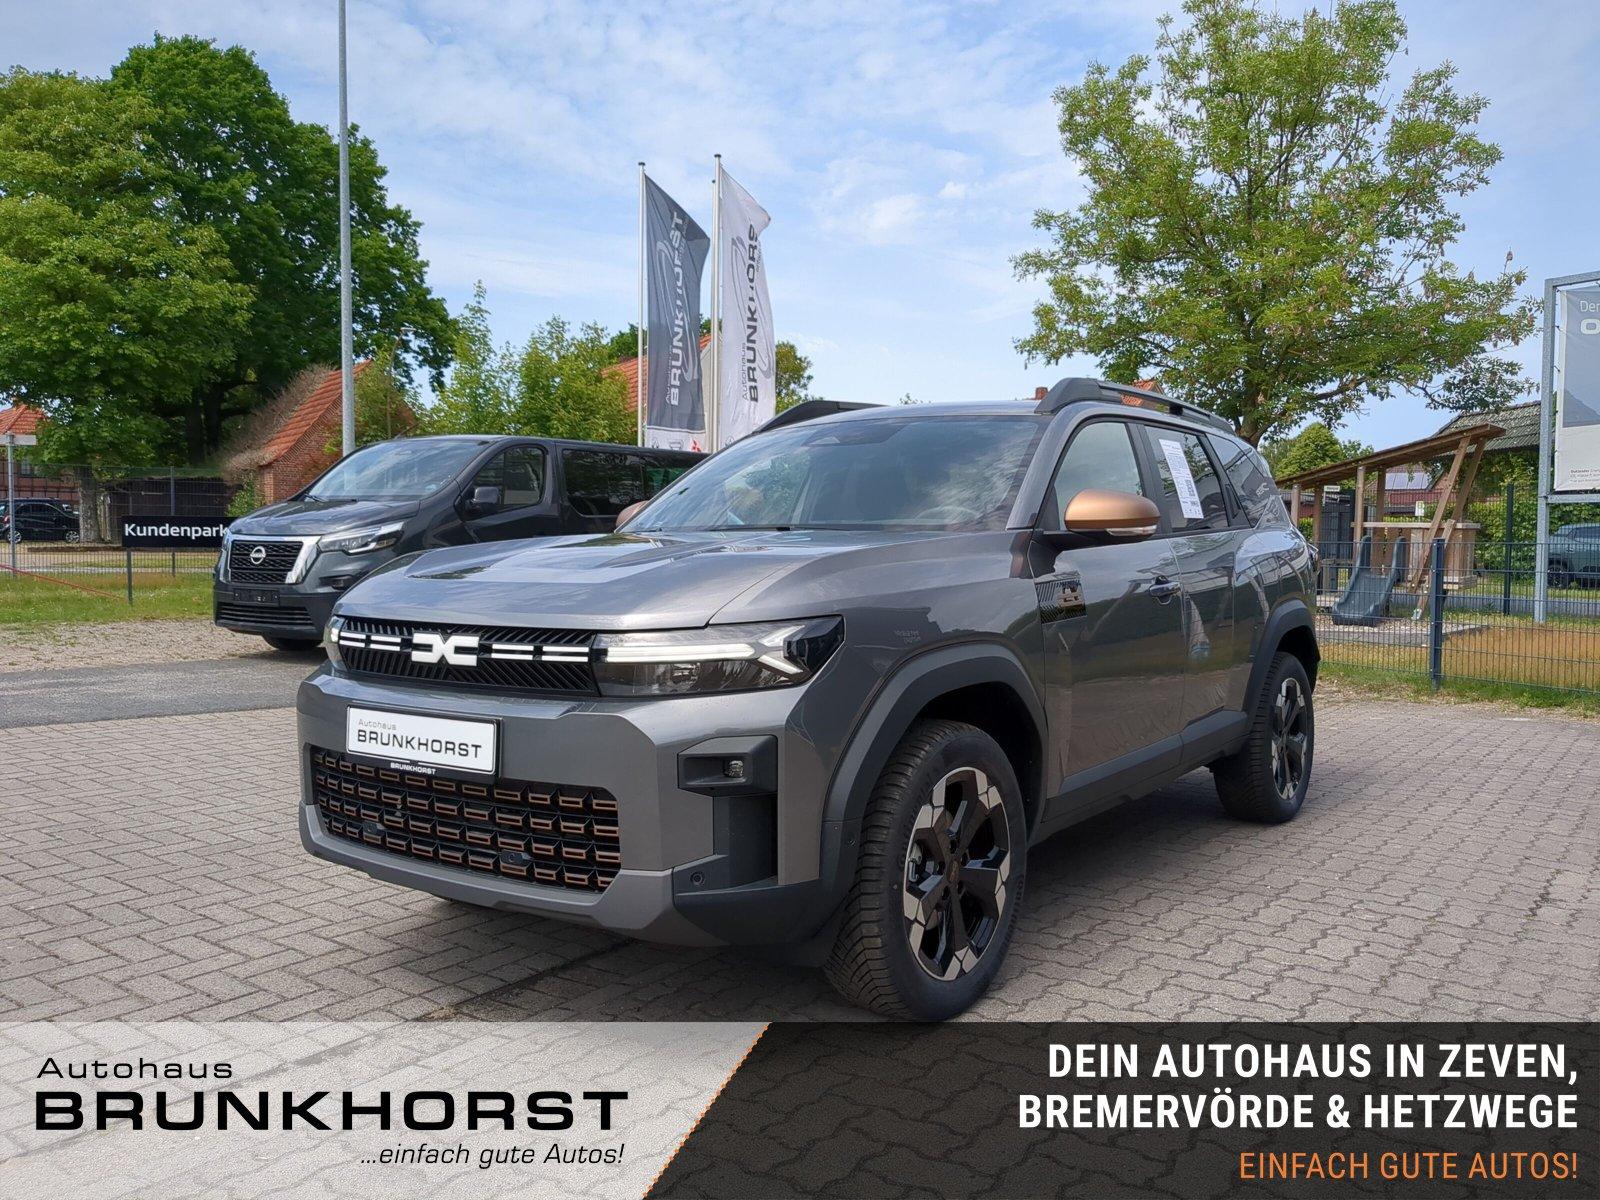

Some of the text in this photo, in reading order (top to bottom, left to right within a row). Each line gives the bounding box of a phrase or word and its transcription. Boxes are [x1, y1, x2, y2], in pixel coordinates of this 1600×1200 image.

[358, 718, 397, 731] Autohaus
[357, 729, 482, 759] BRUNKHORST
[390, 762, 437, 775] BRUNKHORST
